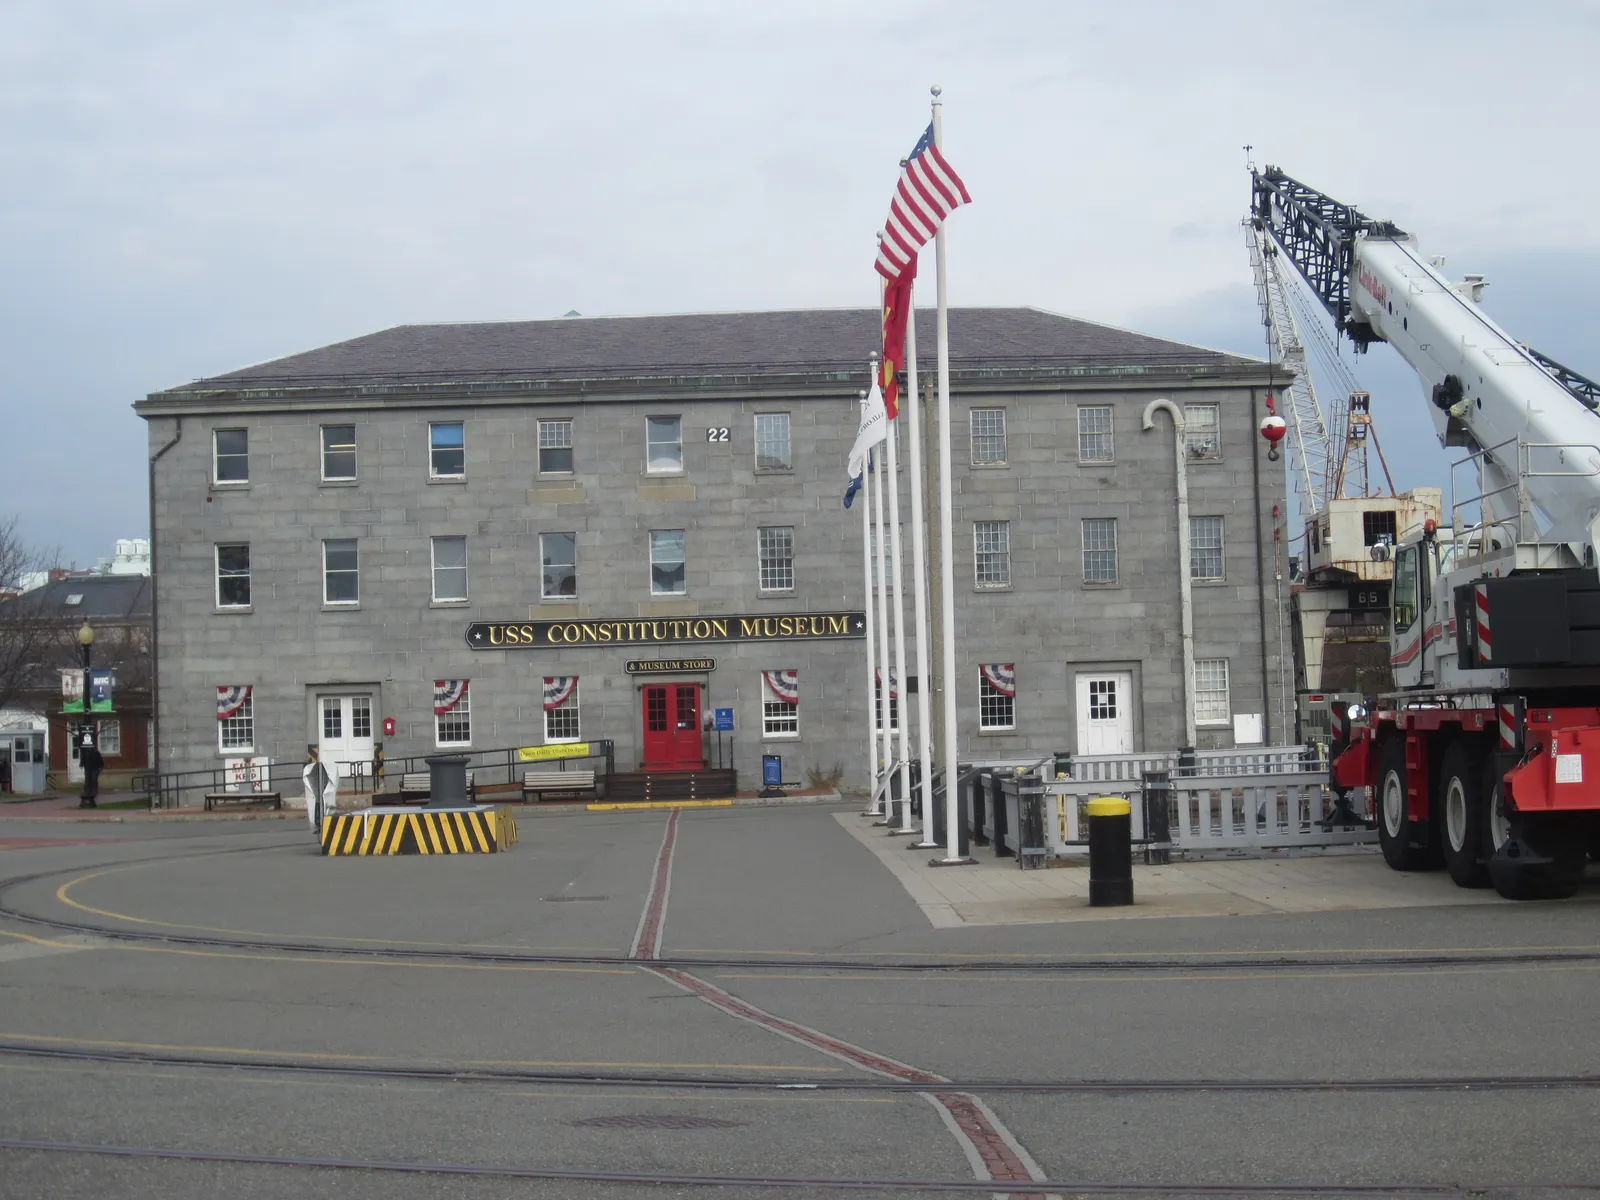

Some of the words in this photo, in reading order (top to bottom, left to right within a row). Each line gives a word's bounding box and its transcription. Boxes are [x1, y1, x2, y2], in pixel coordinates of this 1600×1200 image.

[708, 427, 729, 442] 22
[1358, 591, 1377, 603] 65
[488, 625, 533, 645] USS
[547, 619, 728, 643] CONSTITUTION
[740, 615, 850, 637] MUSEUM
[639, 662, 680, 670] MUSEUM
[683, 660, 712, 669] STORE
